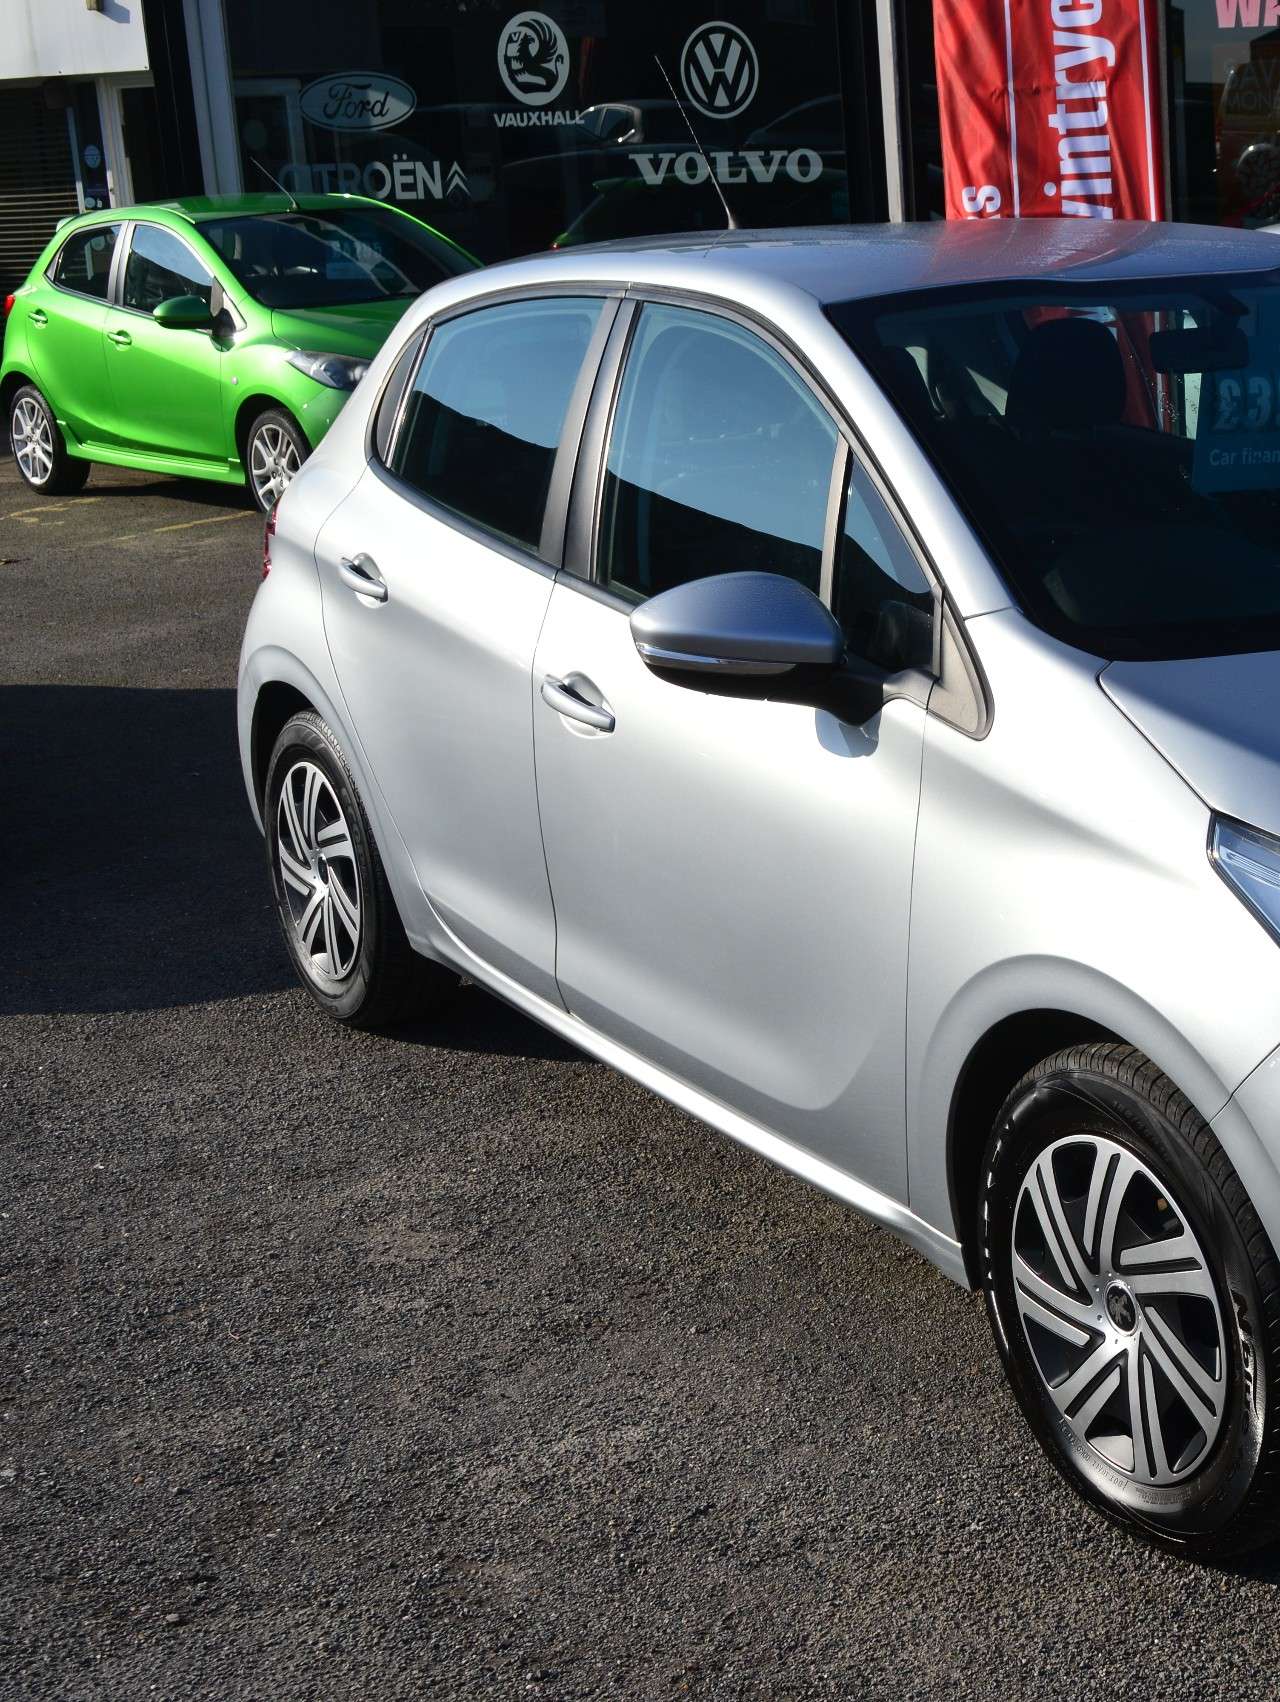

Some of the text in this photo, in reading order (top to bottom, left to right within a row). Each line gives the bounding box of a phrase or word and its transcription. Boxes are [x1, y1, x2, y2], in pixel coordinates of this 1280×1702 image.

[322, 83, 390, 120] Ford
[493, 110, 585, 128] VAUXHALL
[628, 148, 823, 186] VOLVO
[1209, 449, 1236, 467] Car
